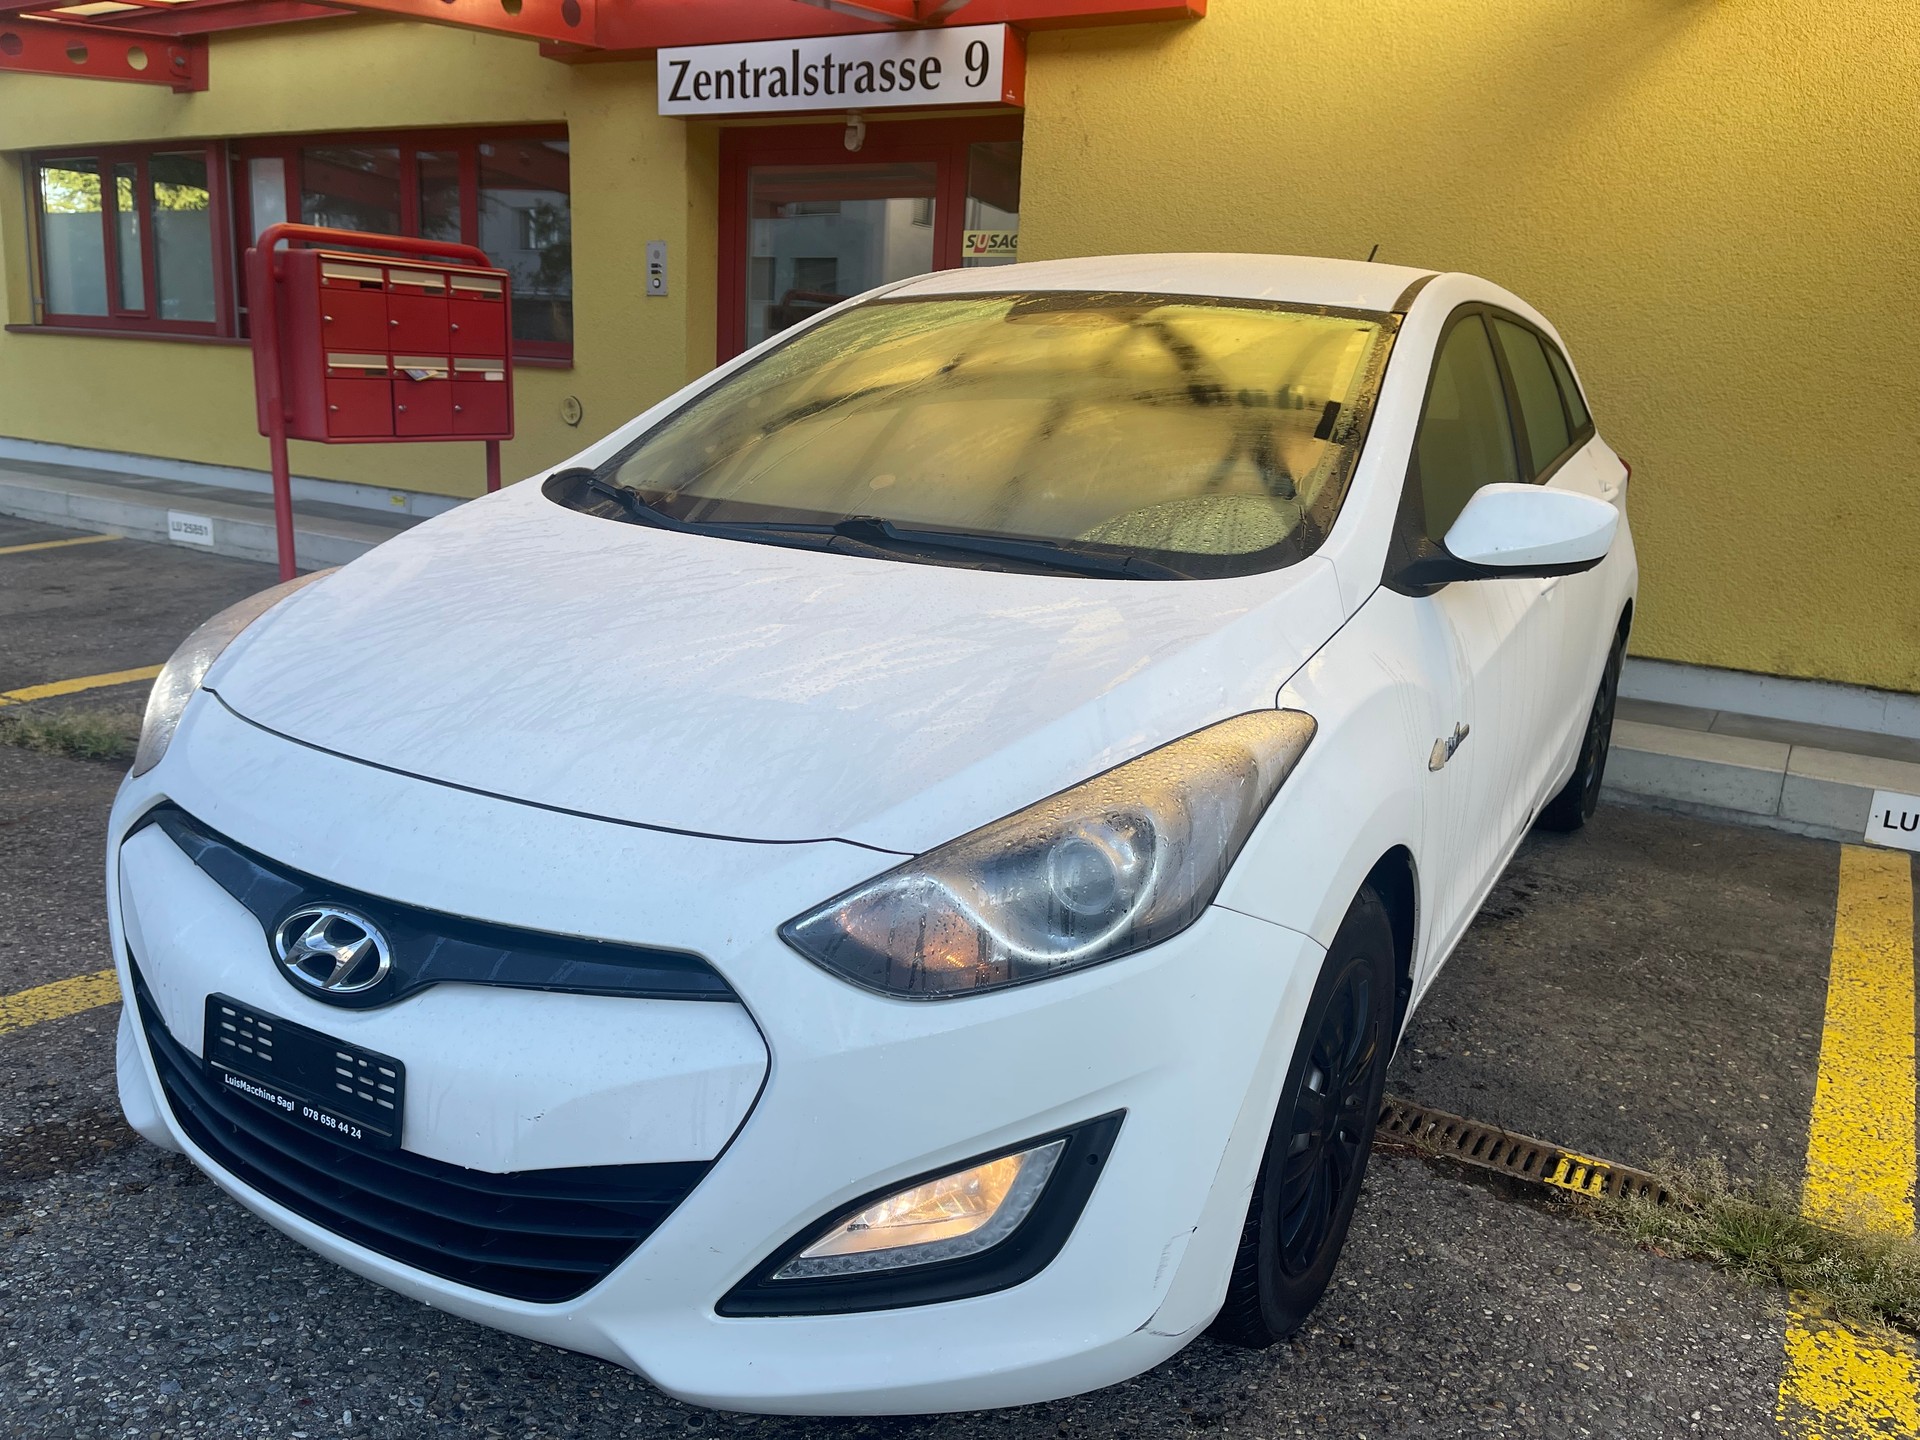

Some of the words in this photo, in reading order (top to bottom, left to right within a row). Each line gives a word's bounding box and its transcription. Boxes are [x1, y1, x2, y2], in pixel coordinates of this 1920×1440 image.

[668, 48, 942, 102] Zentralstrasse
[964, 40, 990, 88] 9
[1883, 809, 1920, 832] LU
[224, 1073, 276, 1103] LuisMacchine
[303, 1106, 319, 1121] 078
[320, 1113, 337, 1128] 658
[337, 1121, 349, 1134] 44
[350, 1126, 362, 1140] 24
